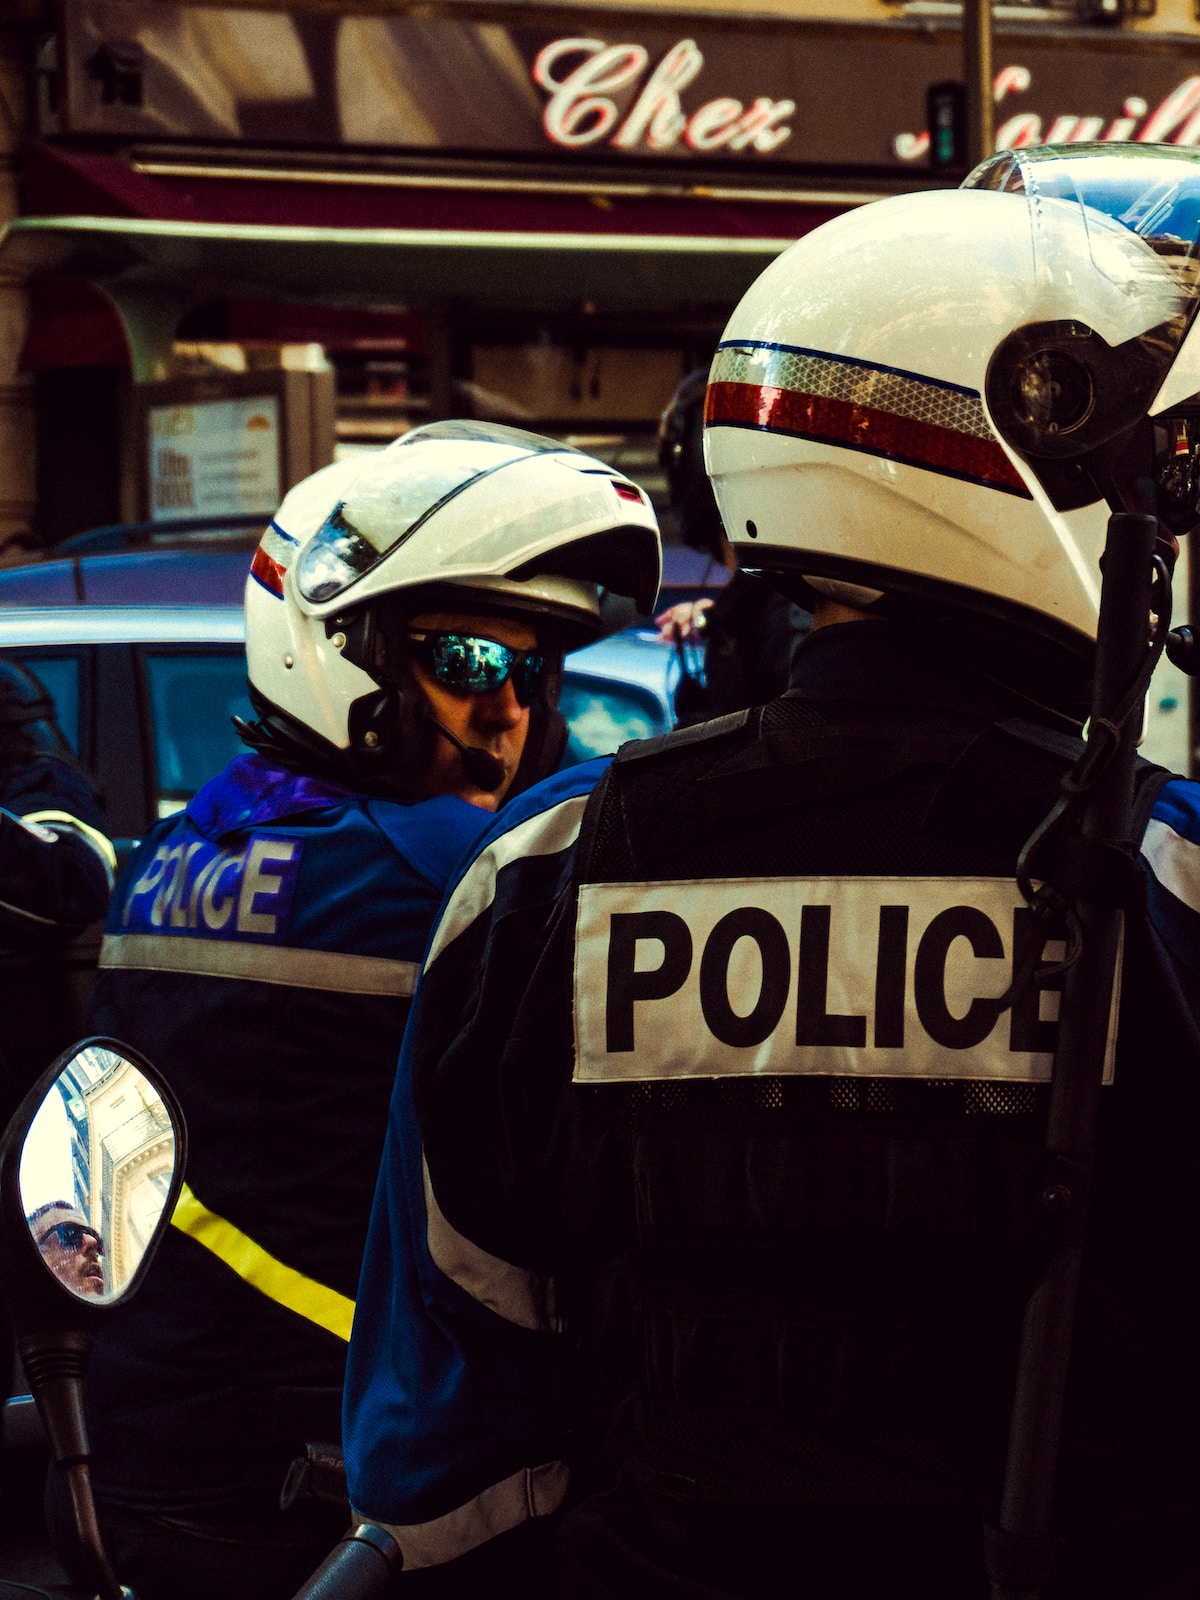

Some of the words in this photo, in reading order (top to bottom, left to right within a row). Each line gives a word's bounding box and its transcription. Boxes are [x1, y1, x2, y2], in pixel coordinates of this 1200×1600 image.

[533, 38, 796, 151] Chez
[122, 839, 296, 935] POLICE
[605, 903, 1061, 1053] POLICE
